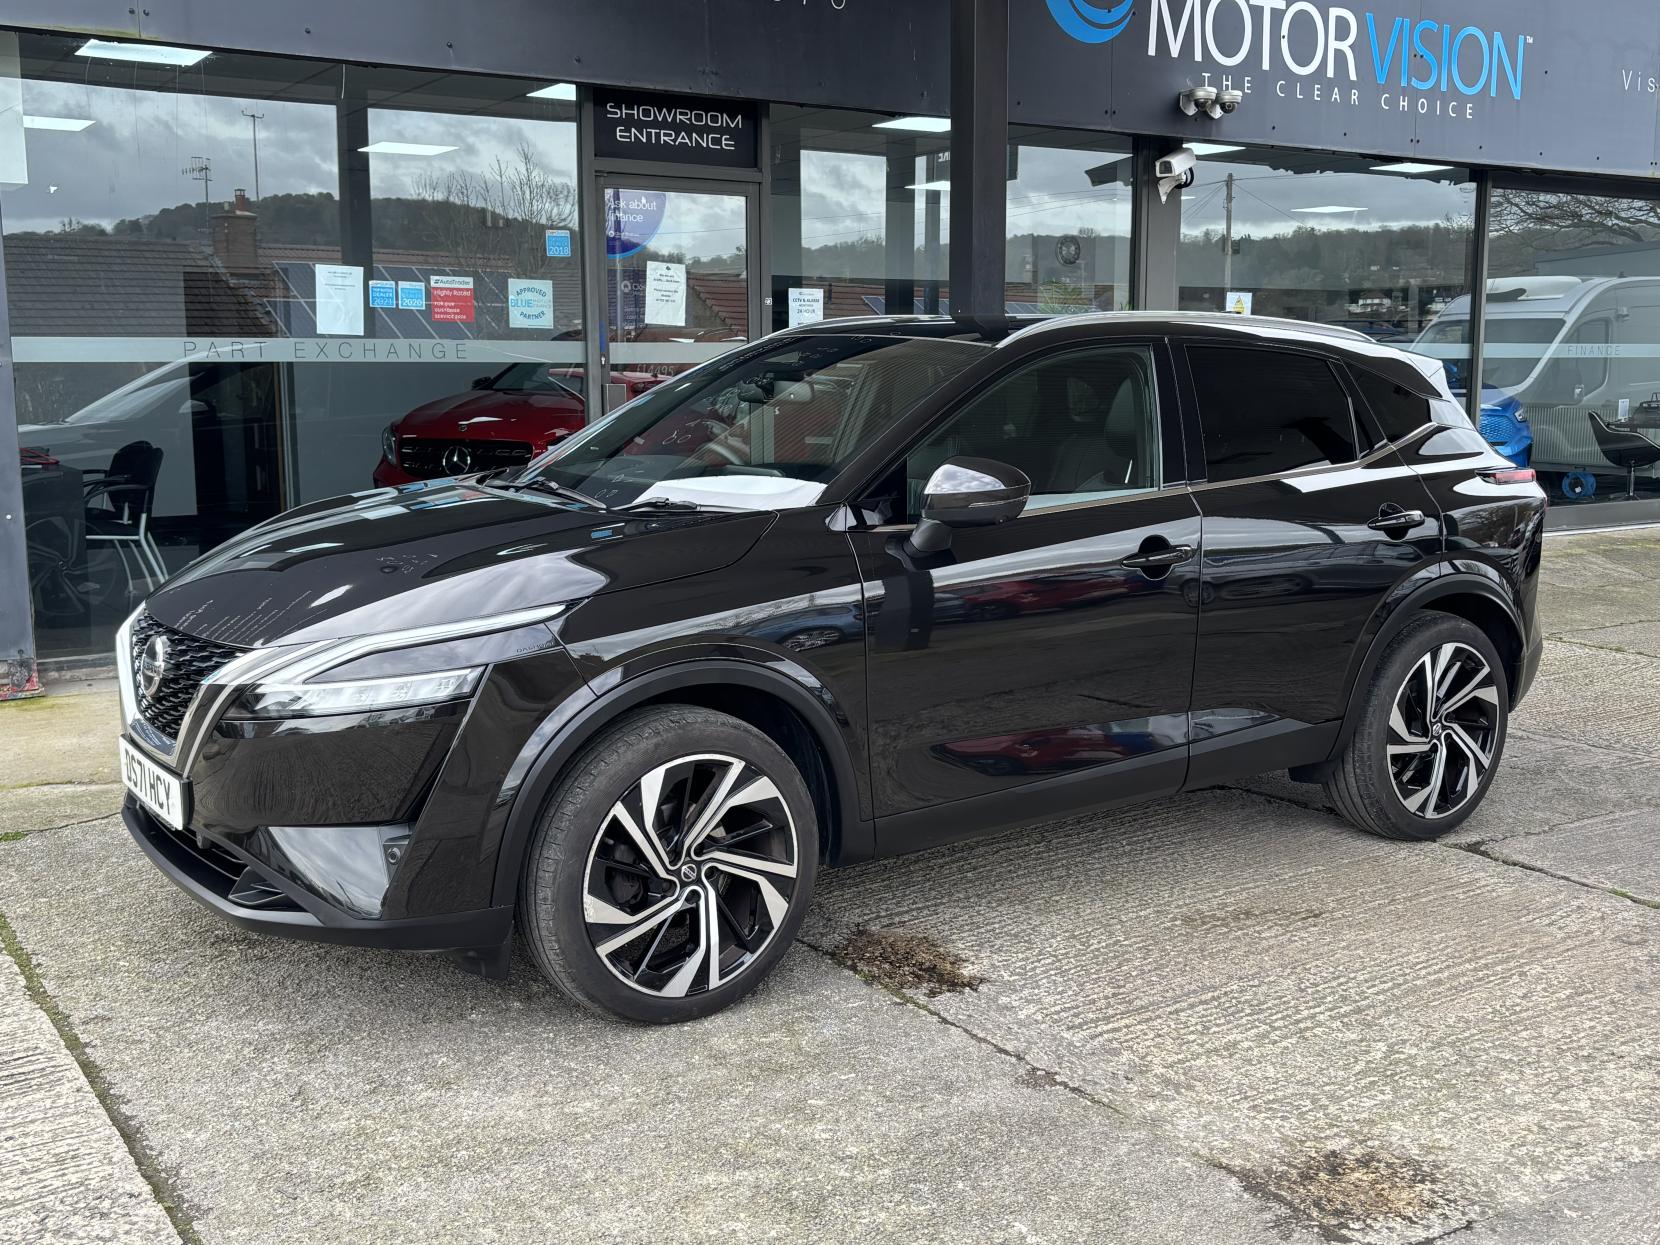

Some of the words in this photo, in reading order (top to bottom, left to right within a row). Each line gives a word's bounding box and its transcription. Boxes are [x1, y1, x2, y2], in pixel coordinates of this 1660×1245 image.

[1147, 0, 1358, 81] MOTOR
[1366, 12, 1525, 100] VISION
[1202, 72, 1252, 94] THE
[1276, 80, 1359, 105] CLEAR
[1381, 93, 1474, 119] CHOICE
[606, 102, 742, 129] SHOWROOM
[616, 126, 735, 150] ENTRANCE
[628, 199, 656, 211] about
[549, 246, 569, 255] 2018
[516, 287, 547, 297] APPROVED
[402, 298, 422, 306] 2020
[510, 298, 533, 308] BLUE
[520, 310, 546, 320] PARTNER
[183, 341, 267, 359] PART
[294, 341, 469, 360] EXCHANGE
[1567, 345, 1621, 356] FINANCE
[124, 747, 147, 797] DS71
[149, 767, 172, 815] HCY
